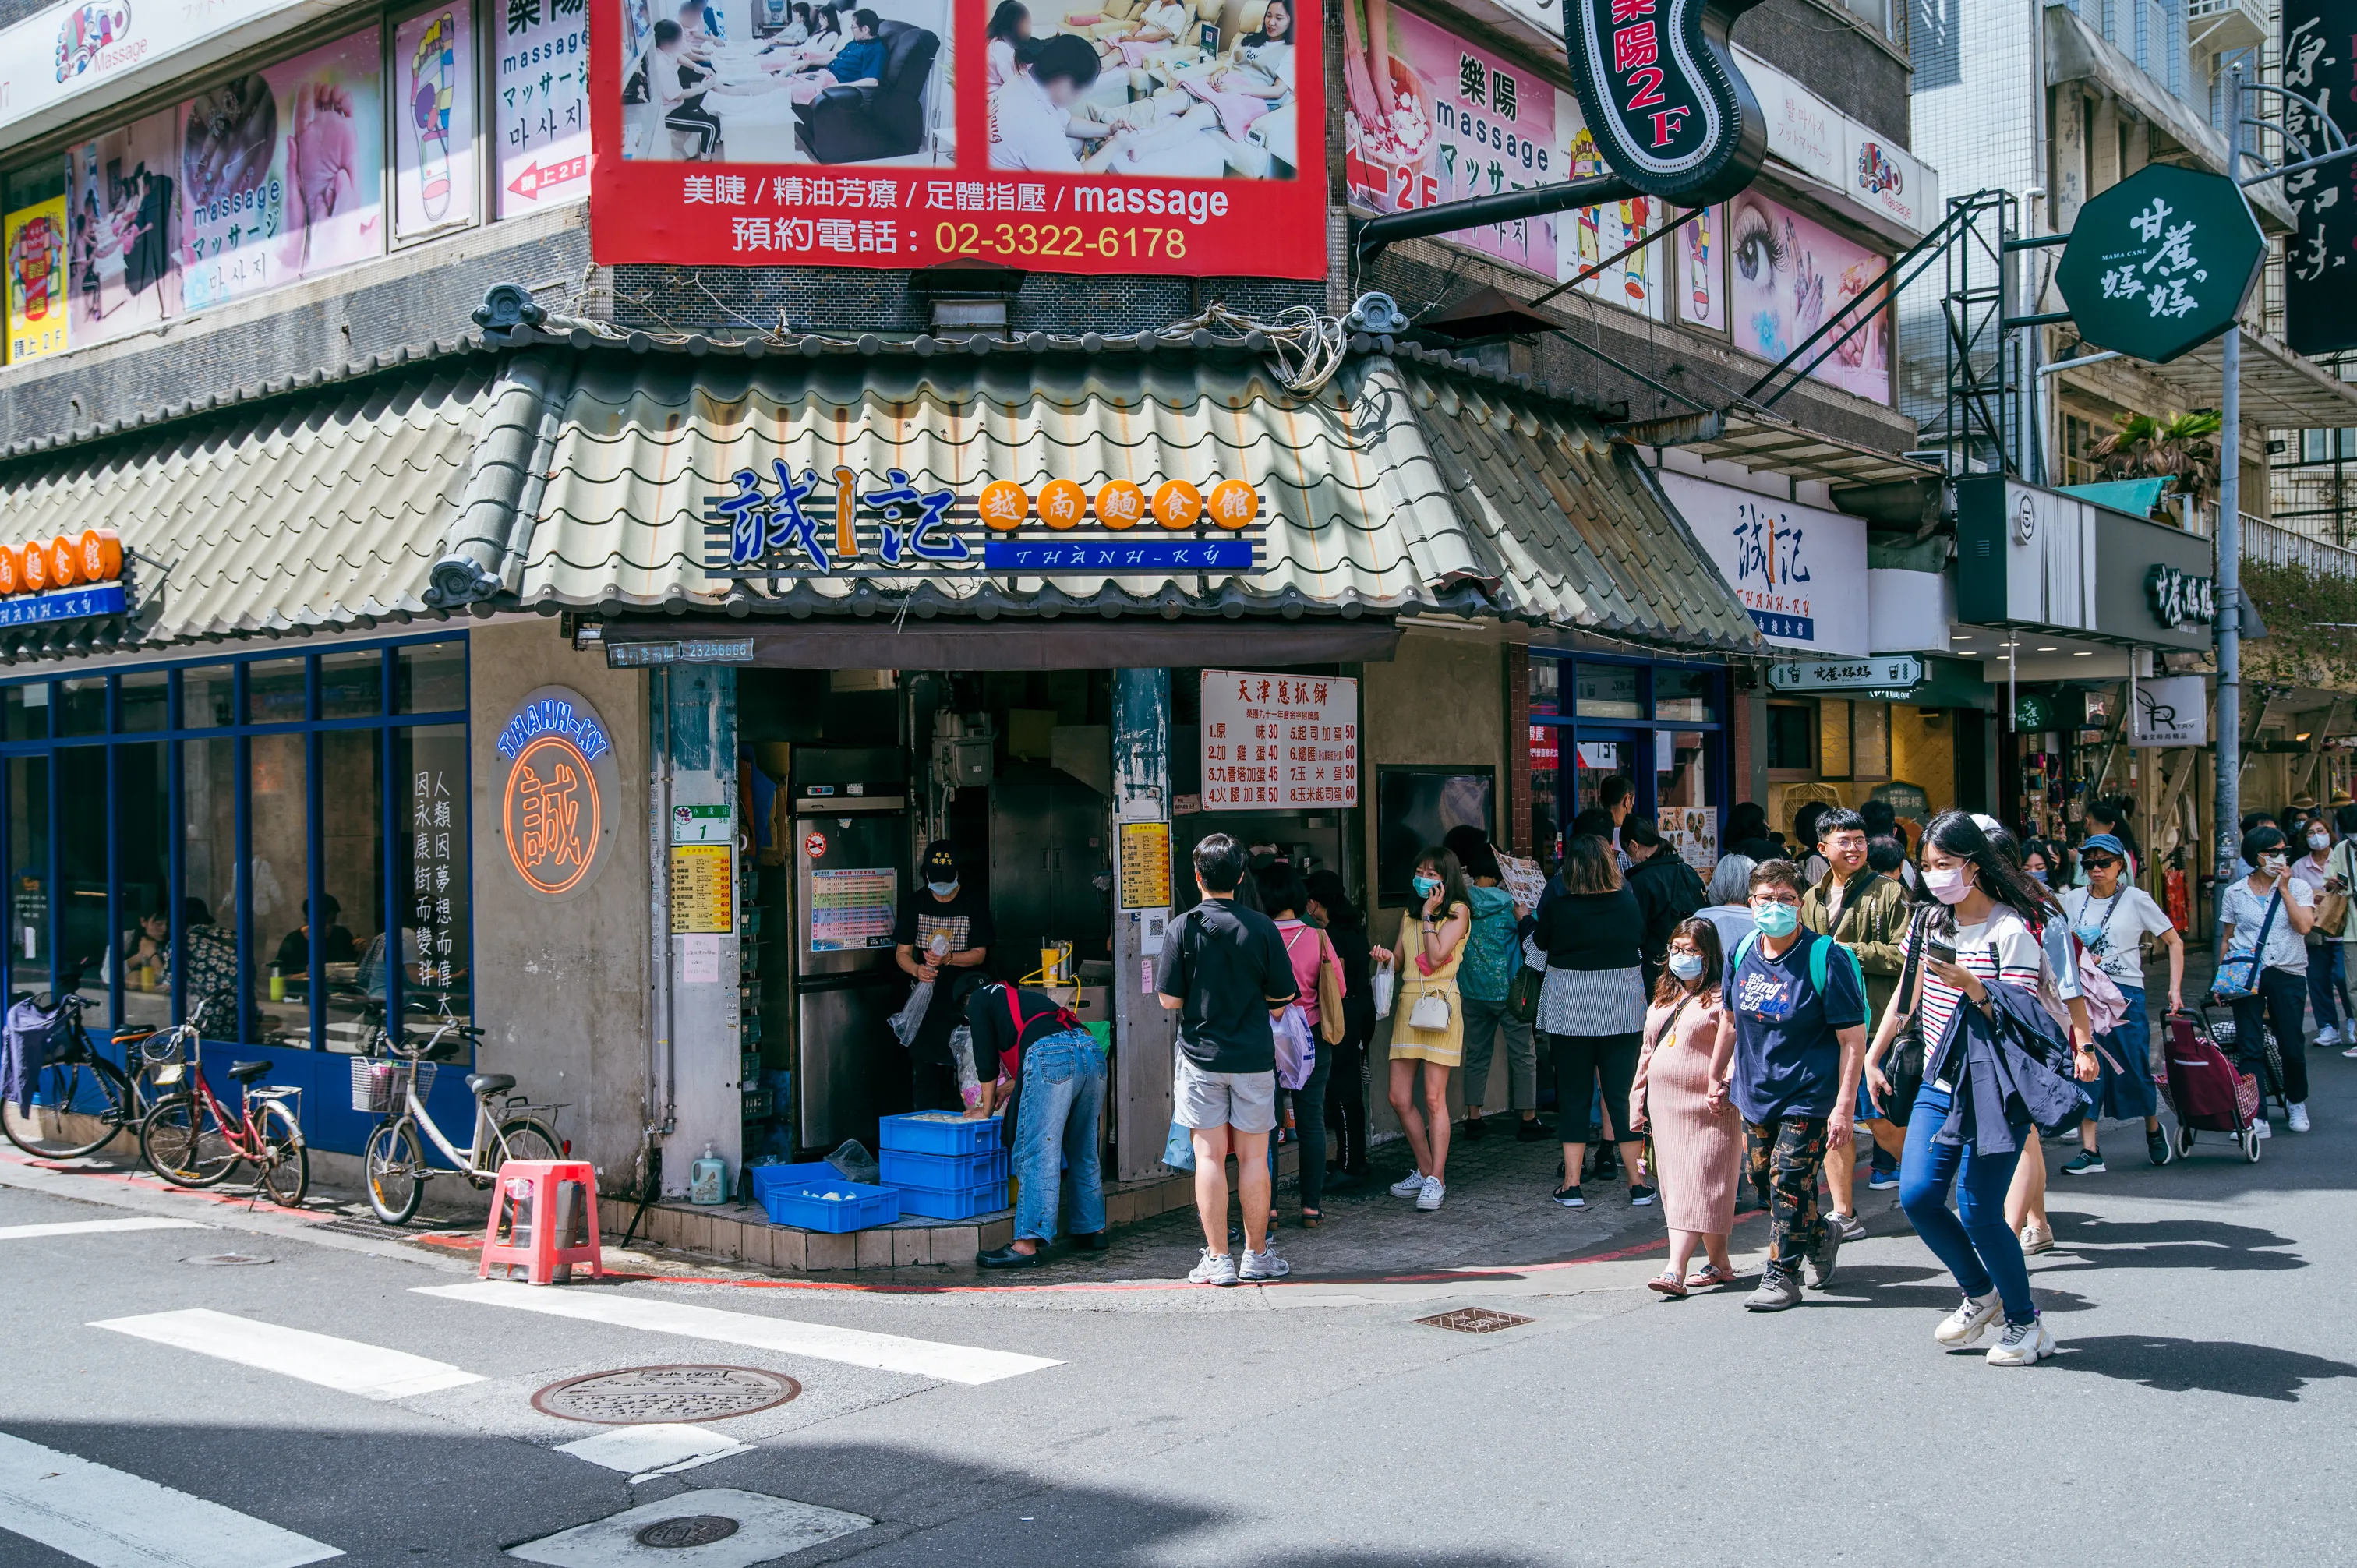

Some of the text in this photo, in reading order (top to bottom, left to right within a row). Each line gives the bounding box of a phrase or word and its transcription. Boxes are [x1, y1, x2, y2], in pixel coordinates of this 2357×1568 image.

[94, 39, 148, 74] Massage
[1460, 52, 1518, 122] 樂陽
[510, 98, 582, 150] 마사지
[1436, 99, 1549, 171] massage
[194, 180, 280, 228] massage
[684, 175, 747, 206] 美睫
[773, 175, 898, 209] 精油芳療
[924, 180, 1047, 213] 足體指壓
[1074, 186, 1228, 225] massage
[1882, 189, 1911, 221] Massage
[193, 208, 279, 260] マッサージ
[935, 221, 1186, 259] 02-3322-6178
[2101, 249, 2147, 260] MAMA CANE
[210, 253, 266, 293] 마사지
[985, 488, 1252, 519] 越南麵食館
[689, 644, 746, 657] 23256666
[1268, 723, 1278, 739] 30
[1345, 725, 1355, 740] 50
[1268, 745, 1278, 761] 40
[1345, 745, 1355, 760] 60
[1268, 766, 1278, 782] 45
[1345, 765, 1355, 779] 50
[1268, 787, 1278, 802] 50
[1345, 785, 1355, 800] 60
[520, 763, 581, 868] 誠
[692, 807, 729, 816] 永康街
[699, 824, 707, 839] 1
[433, 771, 453, 1017] 人類因夢想而偉大
